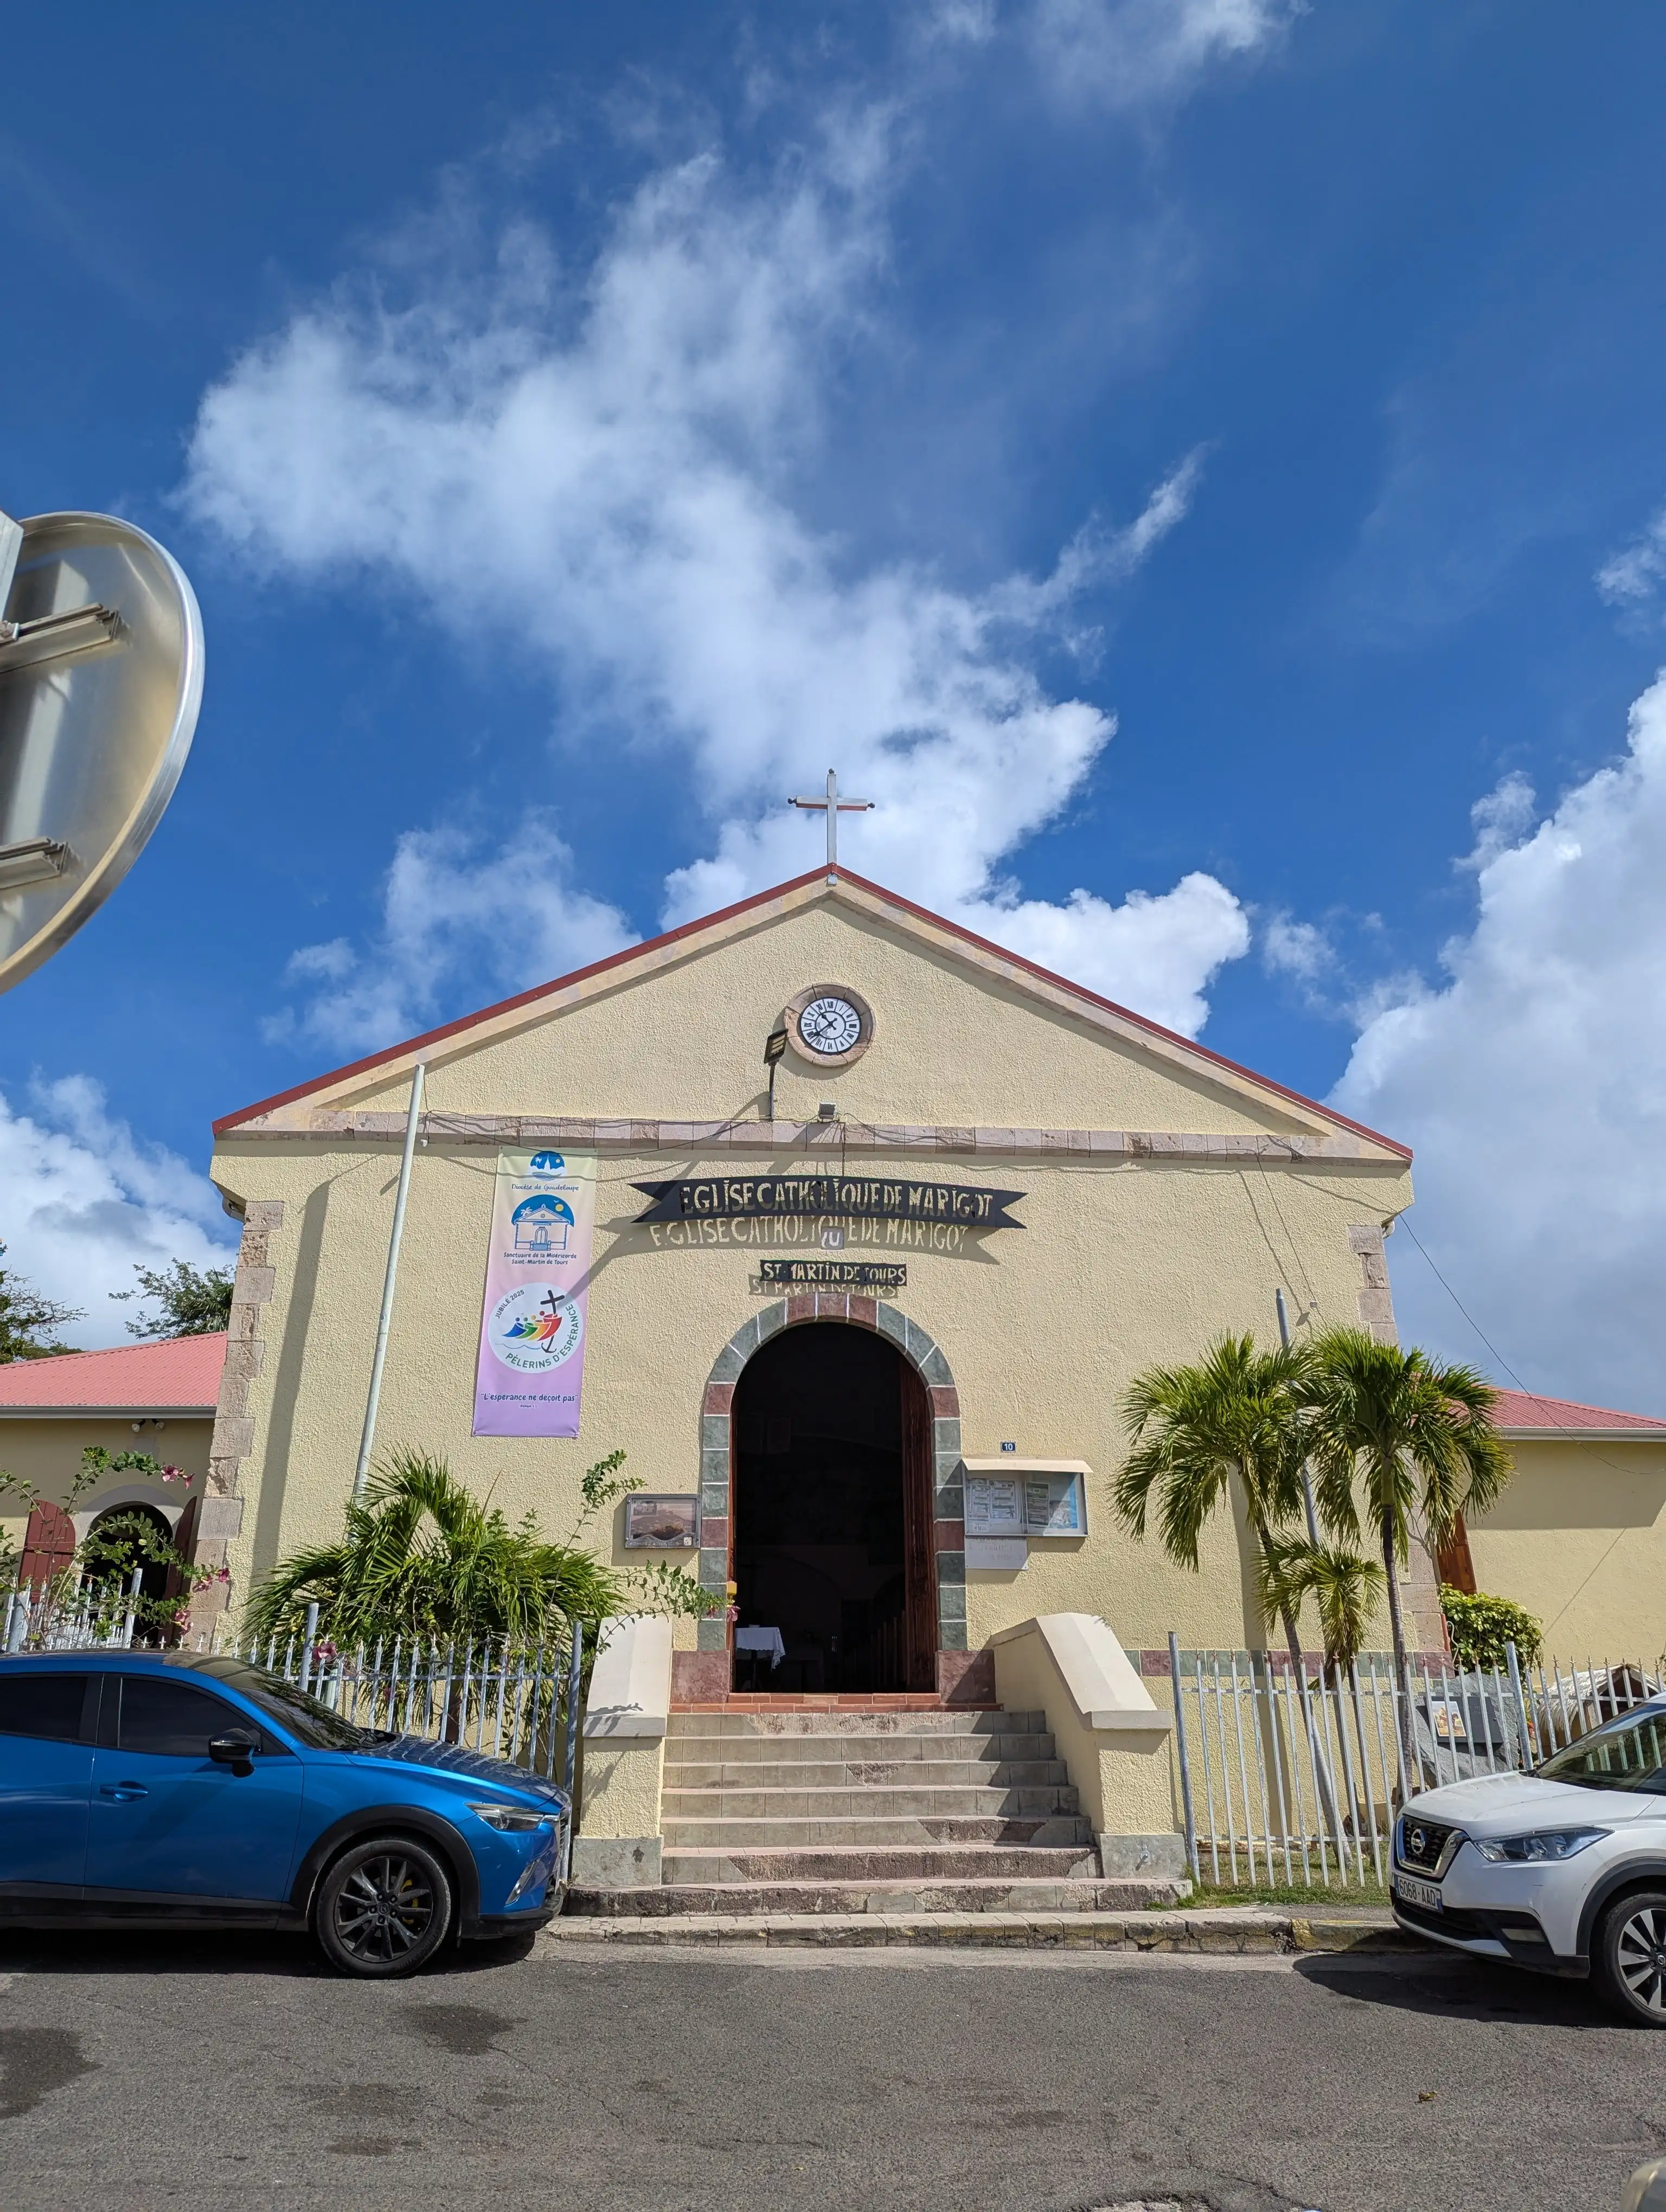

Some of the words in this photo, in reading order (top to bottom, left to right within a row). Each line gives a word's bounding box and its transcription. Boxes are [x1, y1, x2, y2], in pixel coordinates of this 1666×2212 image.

[827, 1041, 832, 1050] VI
[543, 1184, 579, 1192] Guadeloupe
[757, 1178, 881, 1214] CATHOLIQUE
[883, 1184, 903, 1213] DE
[907, 1186, 993, 1219] MARIGOT
[495, 1298, 511, 1319] JUBILÉ
[510, 1289, 524, 1301] 2025
[552, 1303, 579, 1362] D'ESPÉRANCE
[539, 1393, 561, 1404] déçoit
